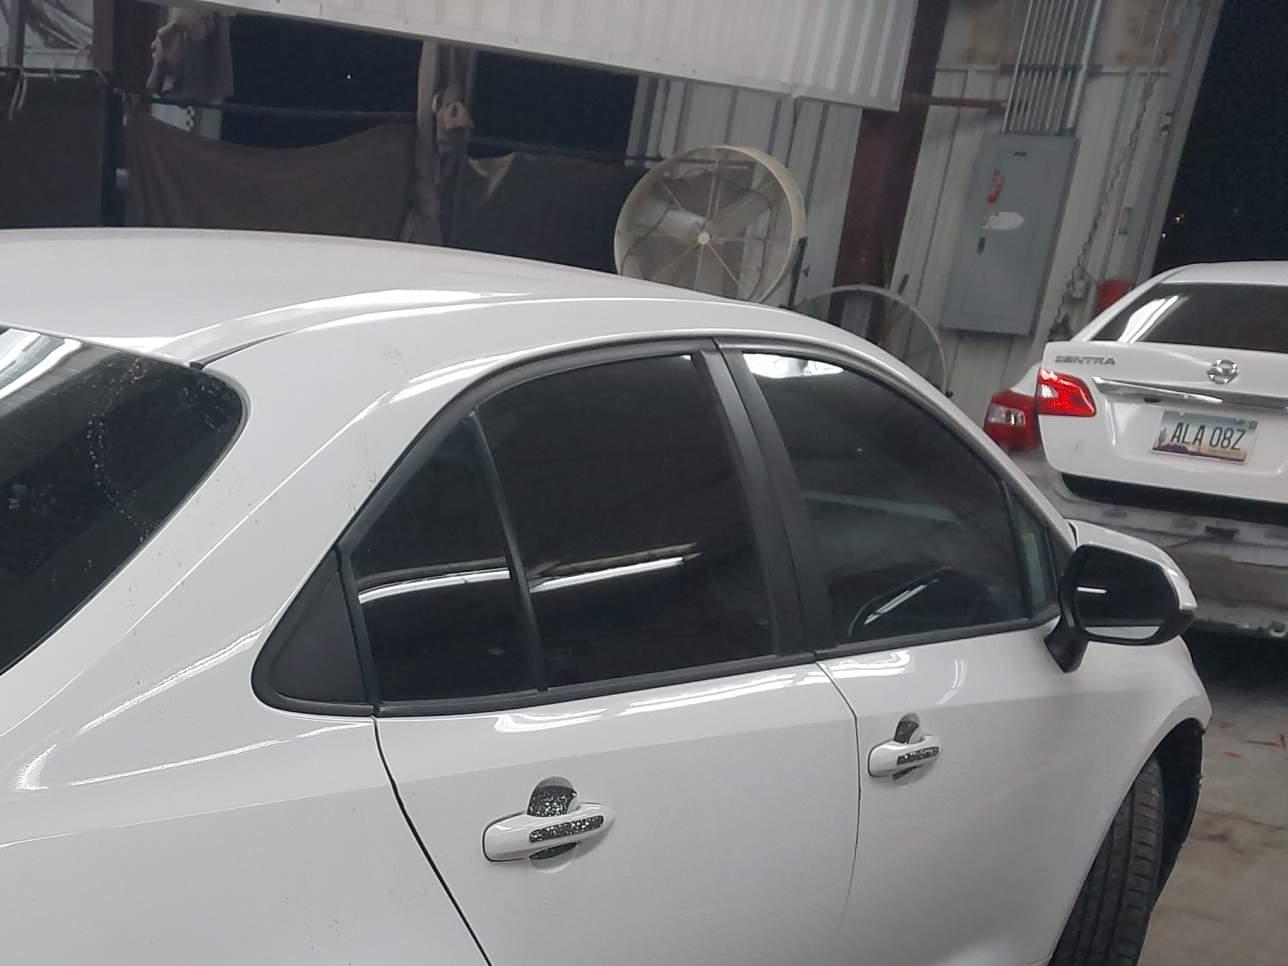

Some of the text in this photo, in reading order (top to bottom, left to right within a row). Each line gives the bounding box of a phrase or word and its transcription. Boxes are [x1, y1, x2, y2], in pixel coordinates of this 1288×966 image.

[1055, 355, 1115, 365] SENTRA
[1171, 422, 1206, 446] ALA
[1209, 426, 1246, 451] 08Z
